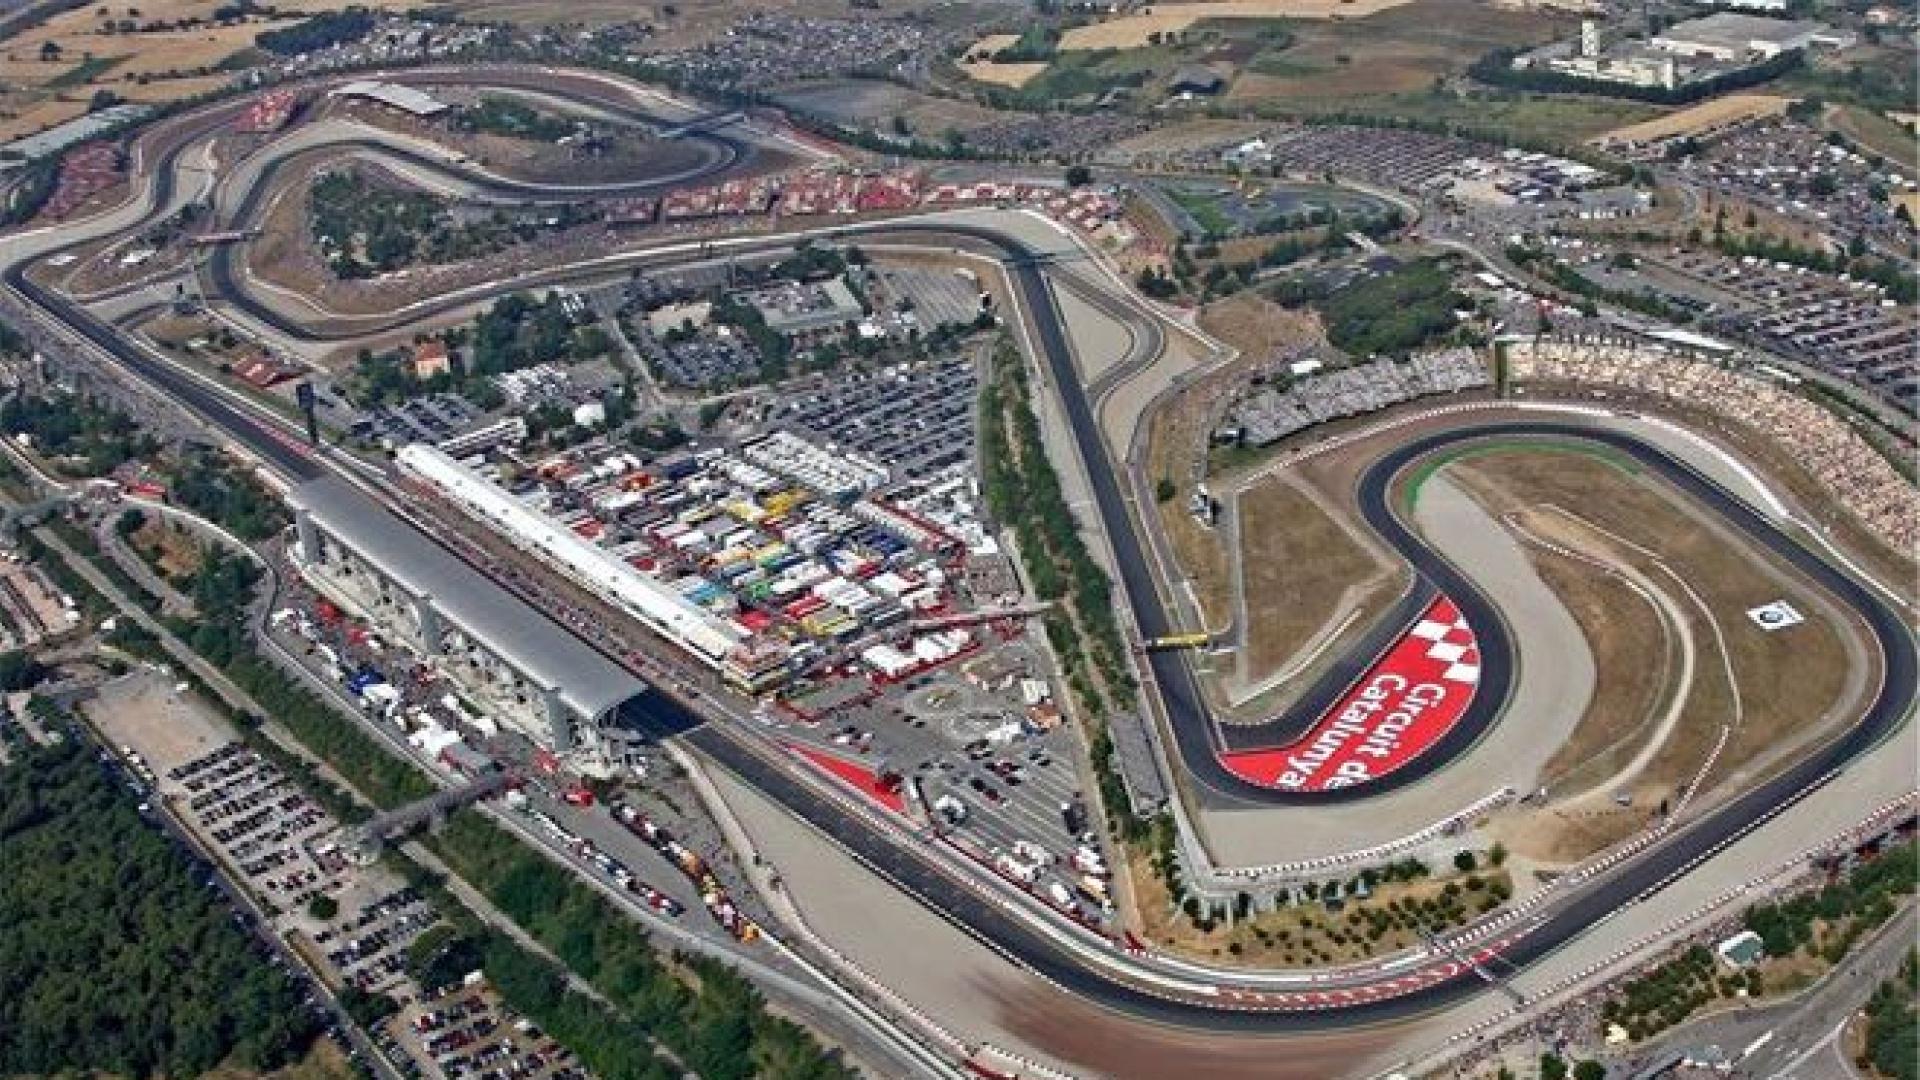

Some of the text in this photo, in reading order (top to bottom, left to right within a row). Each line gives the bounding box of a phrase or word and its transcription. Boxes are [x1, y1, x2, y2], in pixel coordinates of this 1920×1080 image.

[1276, 674, 1407, 787] Catalunya
[1323, 684, 1446, 789] Circuit de
